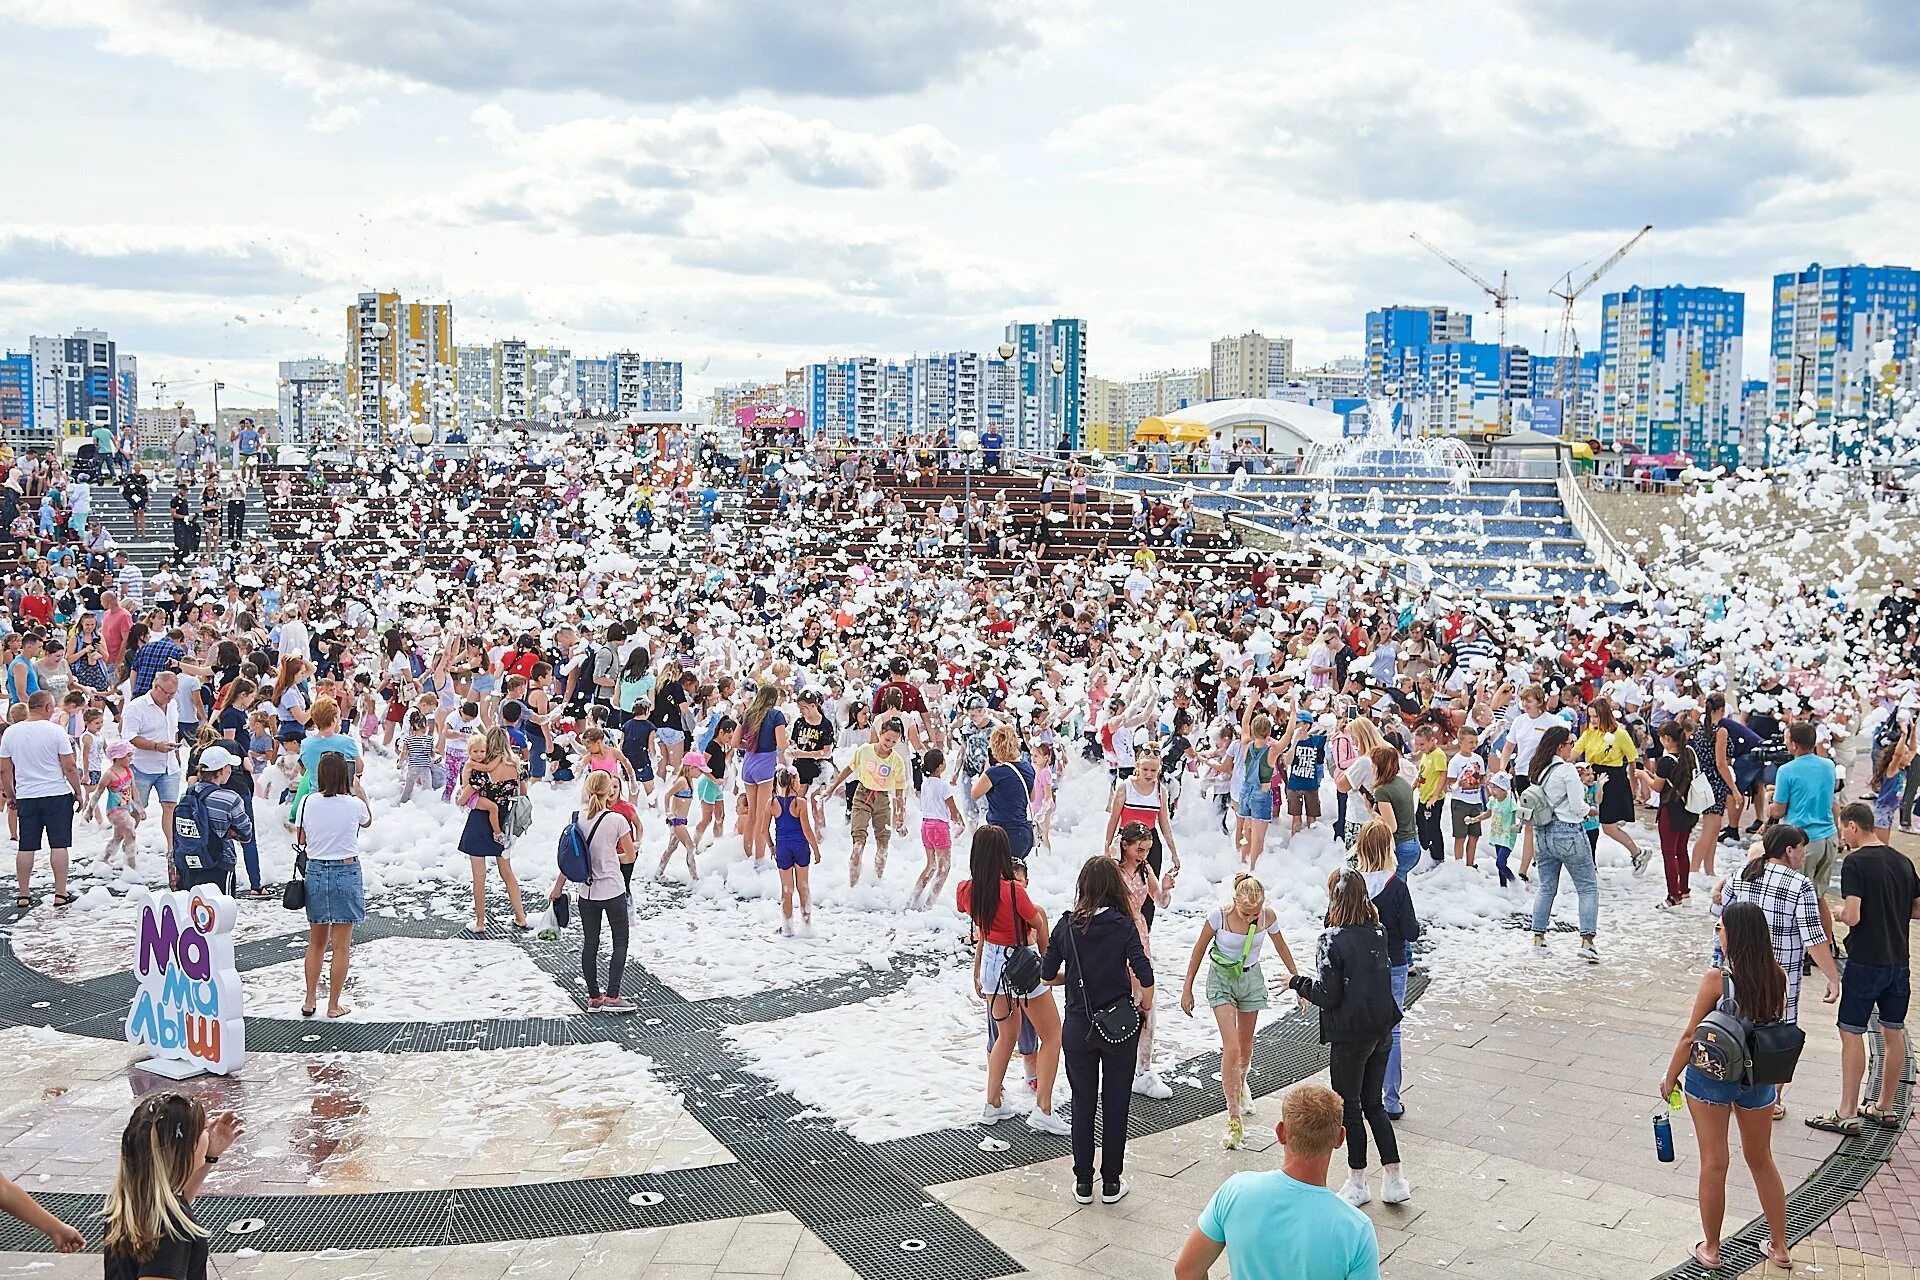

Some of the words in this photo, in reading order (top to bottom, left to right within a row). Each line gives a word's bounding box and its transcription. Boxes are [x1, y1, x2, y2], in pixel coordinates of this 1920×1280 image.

[1296, 746, 1318, 759] RIDE
[1298, 757, 1316, 769] THE
[1292, 764, 1316, 779] WAVE
